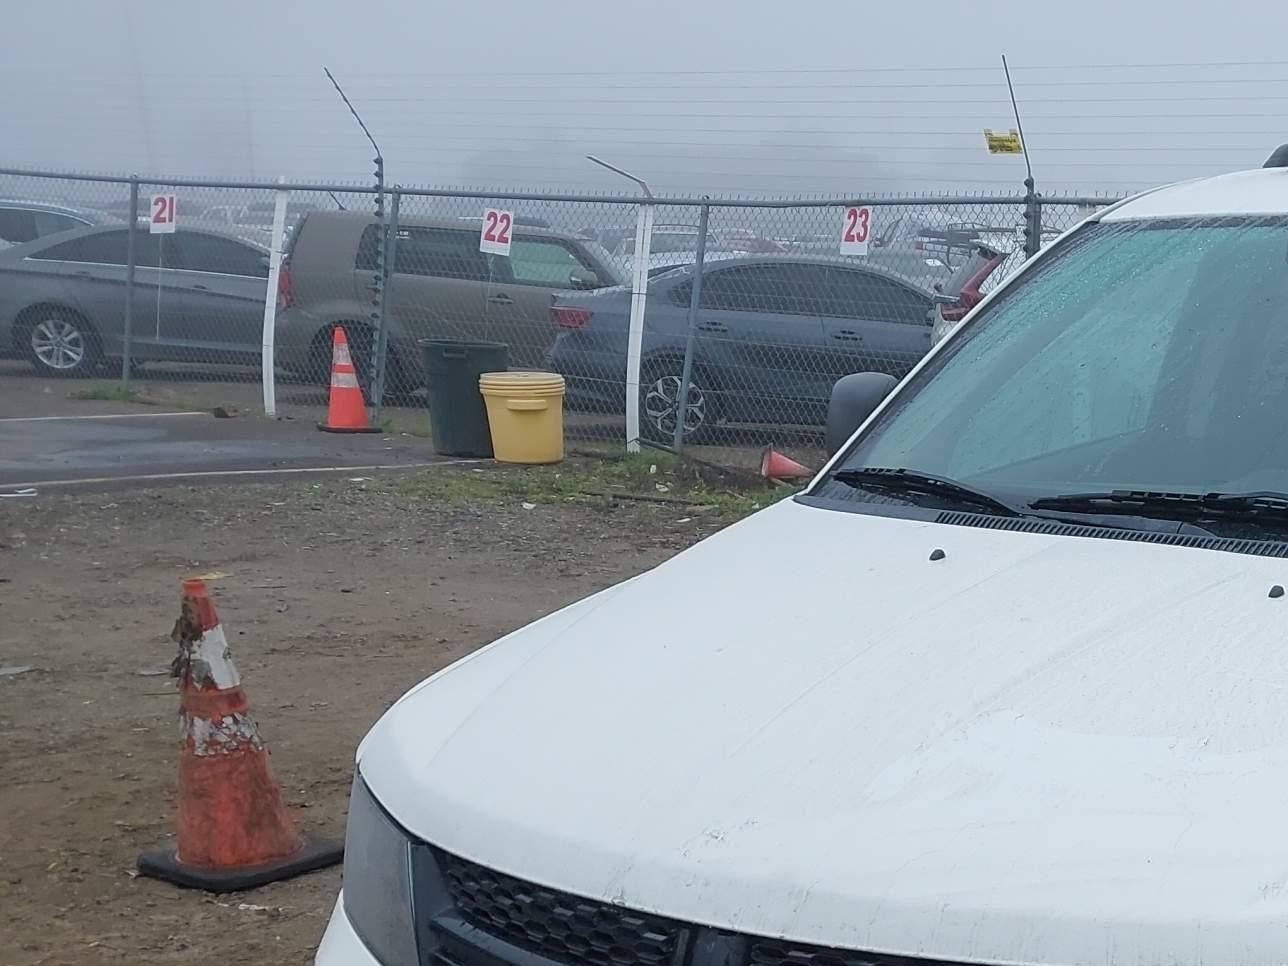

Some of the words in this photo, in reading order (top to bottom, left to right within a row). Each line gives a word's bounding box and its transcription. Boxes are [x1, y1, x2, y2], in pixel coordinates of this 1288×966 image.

[152, 196, 175, 223] 21
[844, 207, 869, 243] 23
[483, 211, 510, 244] 22
